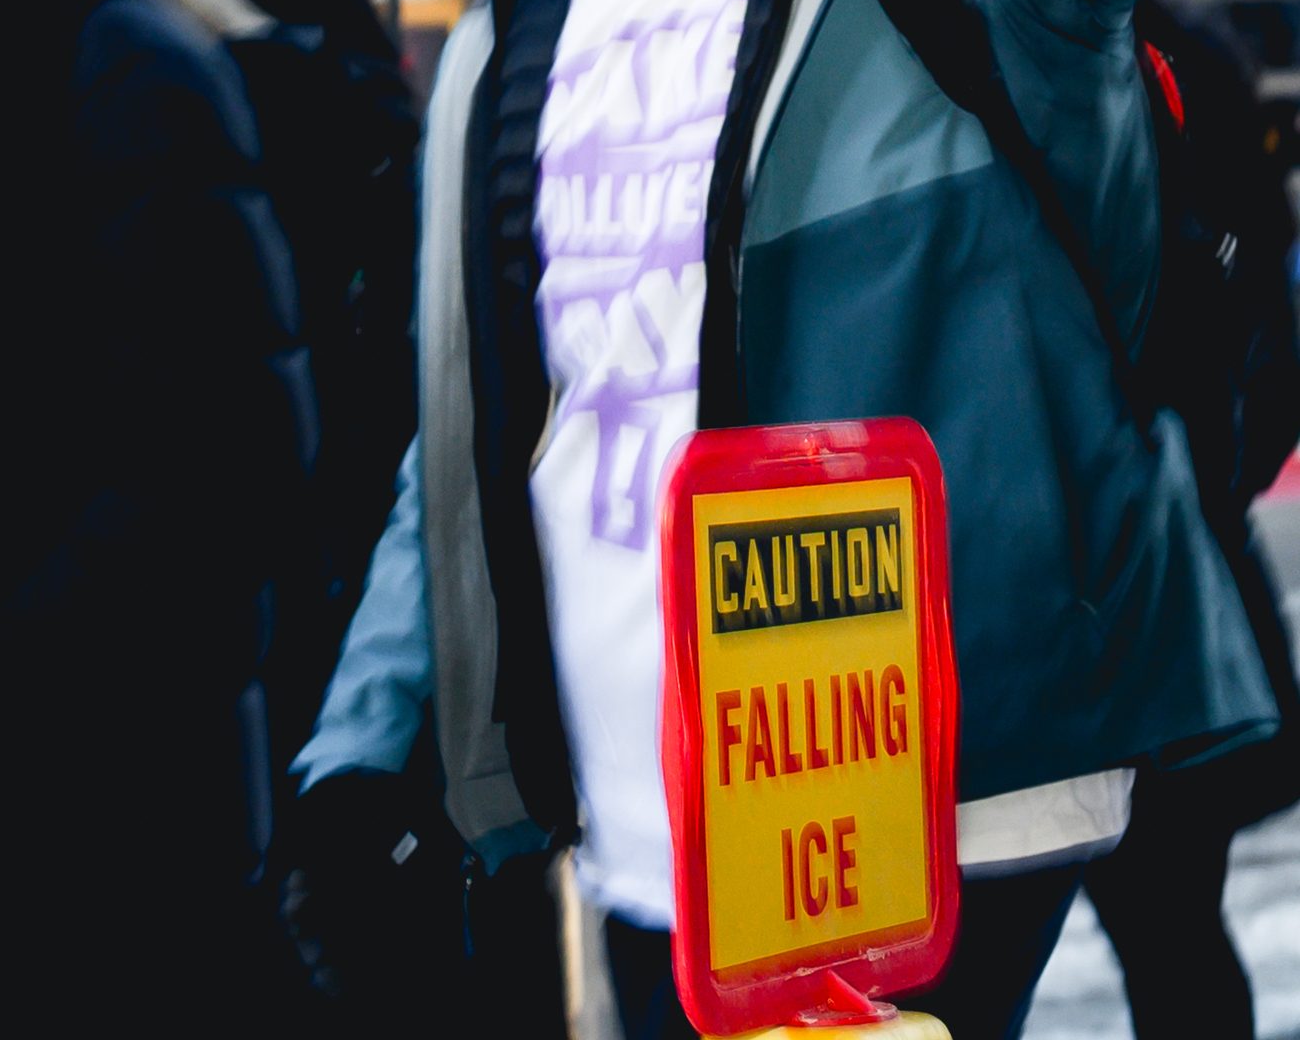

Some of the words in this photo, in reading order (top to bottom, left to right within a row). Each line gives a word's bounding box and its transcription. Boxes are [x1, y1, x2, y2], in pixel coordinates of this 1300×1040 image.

[713, 523, 899, 615] CAUTION
[716, 664, 908, 787] FALLING
[781, 816, 859, 922] ICE
